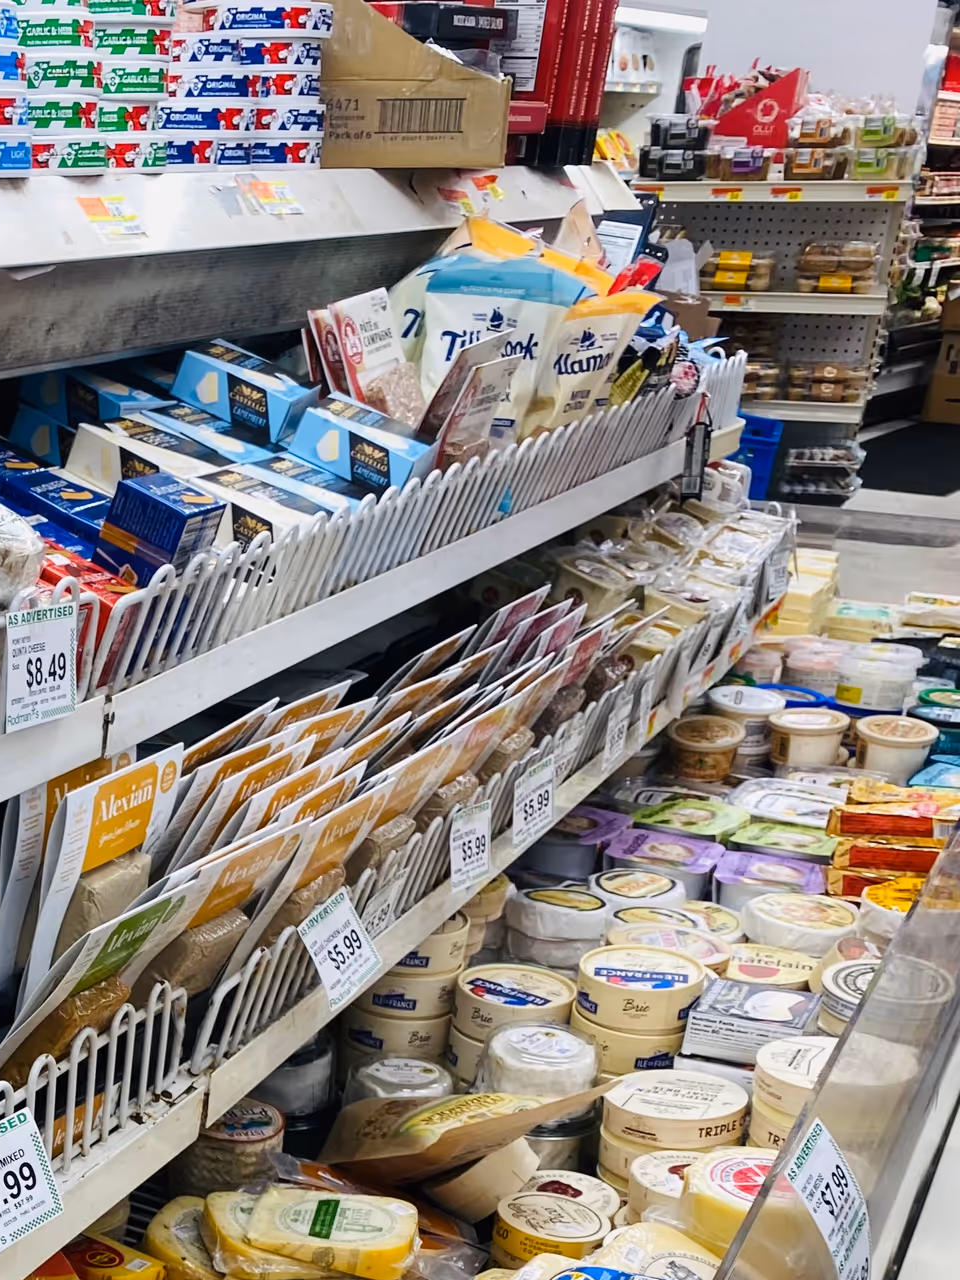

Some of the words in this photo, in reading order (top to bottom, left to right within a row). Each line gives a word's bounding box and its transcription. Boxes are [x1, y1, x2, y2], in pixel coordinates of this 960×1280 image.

[329, 131, 352, 140] Pack
[353, 131, 365, 140] of
[365, 131, 372, 140] 6
[8, 614, 19, 627] AS
[21, 605, 74, 624] ADVERTISED
[26, 652, 67, 690] $8.49
[97, 782, 153, 822] Alexian
[524, 789, 550, 821] $5.99
[462, 834, 486, 861] $5.99
[327, 928, 362, 971] $5.99
[470, 1007, 494, 1026] Brie
[622, 998, 651, 1014] Brie
[408, 1030, 433, 1045] Brie
[698, 1120, 737, 1139] TRIPLE
[787, 1170, 796, 1183] AS
[794, 1122, 824, 1171] ADVERTISED
[821, 1164, 849, 1218] $7.99
